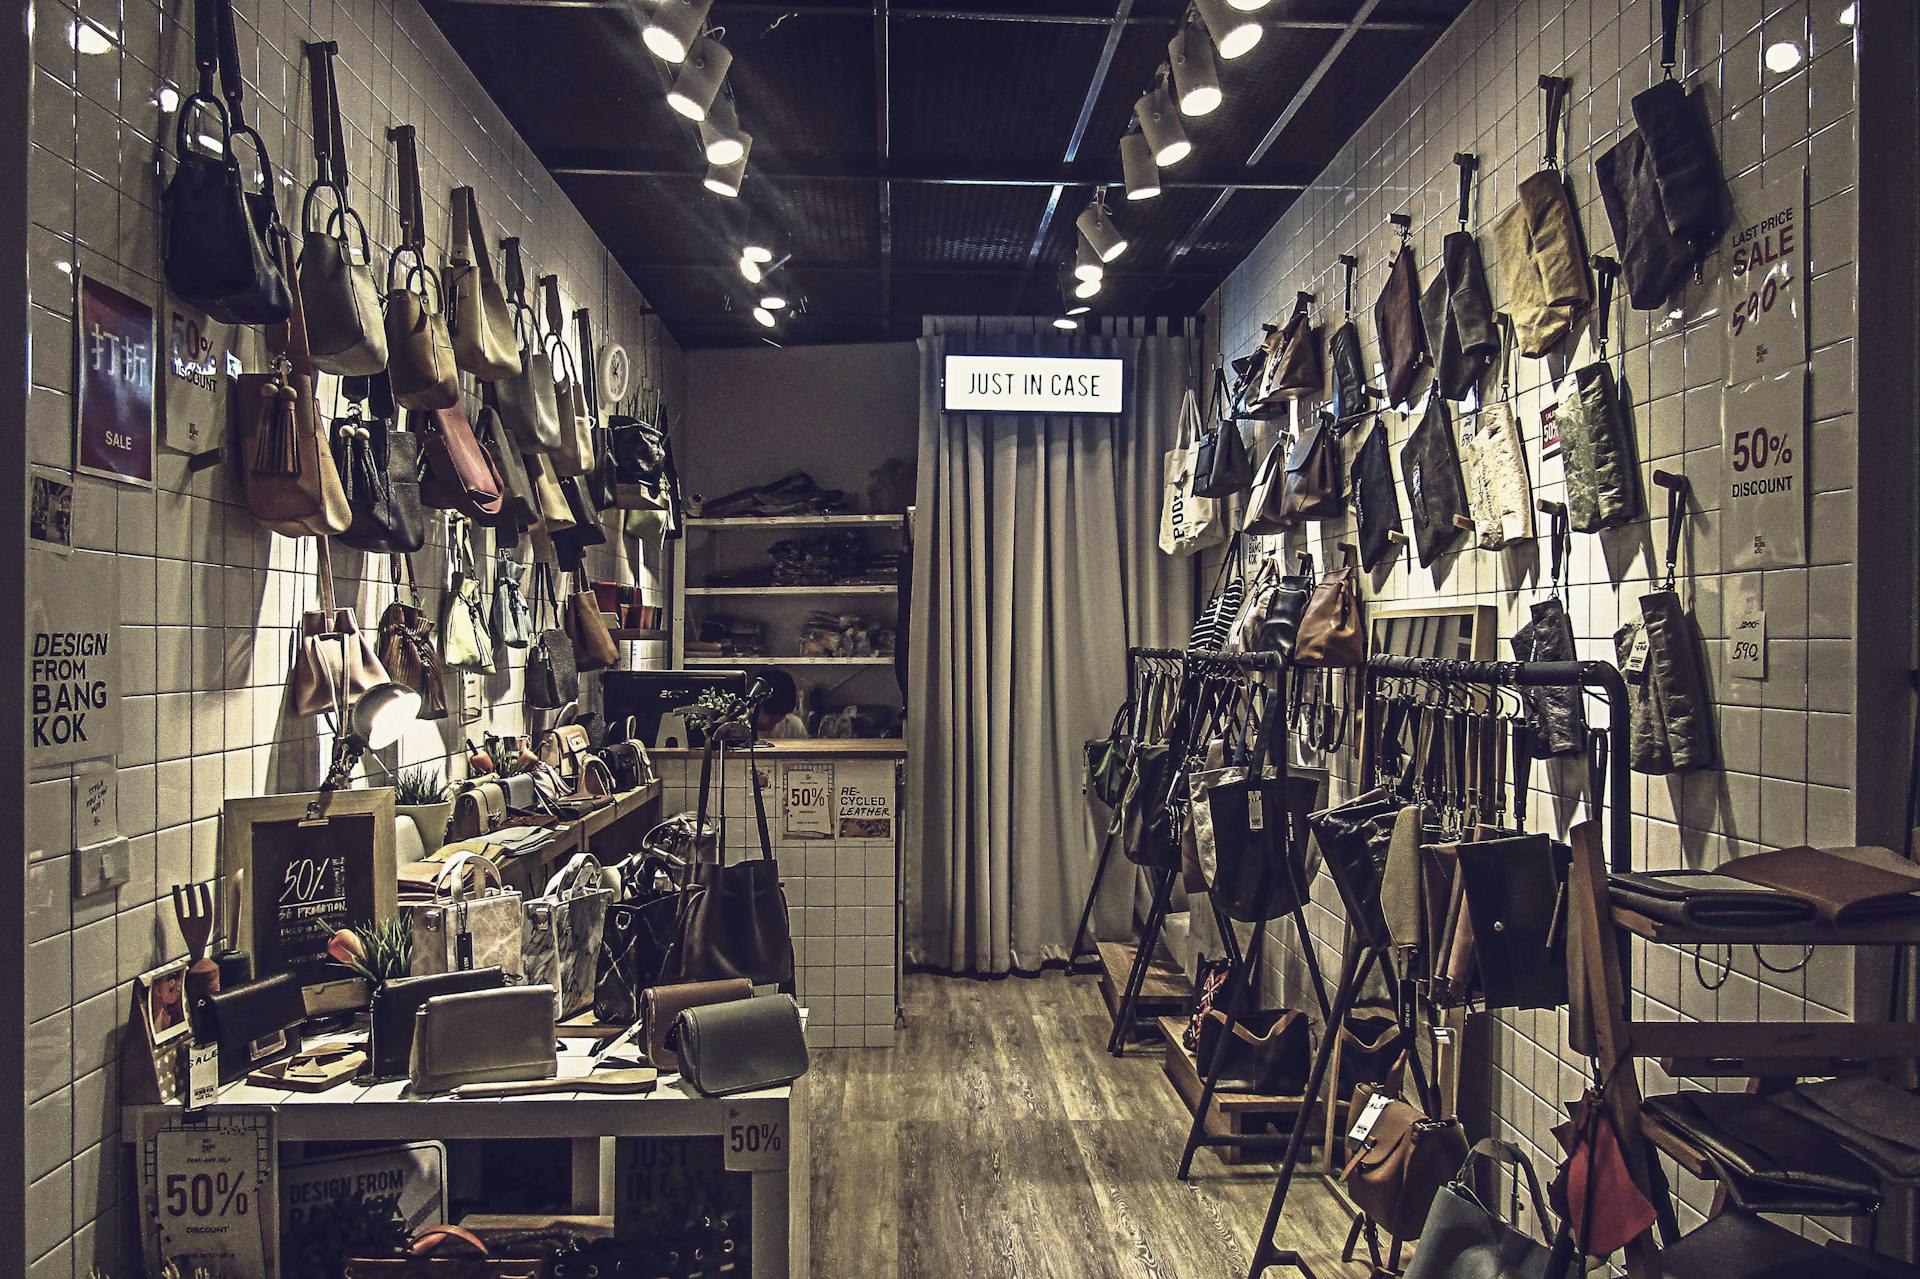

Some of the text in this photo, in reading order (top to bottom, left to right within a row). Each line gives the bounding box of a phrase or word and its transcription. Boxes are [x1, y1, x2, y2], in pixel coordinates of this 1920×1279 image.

[1732, 207, 1794, 249] LAST PRICE
[1732, 223, 1794, 277] SALE
[171, 311, 218, 369] 50%
[91, 322, 147, 388] 打折
[968, 372, 1101, 397] JUST IN CASE
[105, 430, 133, 451] SALE
[1731, 427, 1793, 472] 50%
[1731, 475, 1793, 498] DISCOUNT
[33, 632, 109, 658] DESIGN
[33, 659, 86, 682] FROM
[33, 681, 107, 715] BANG
[33, 712, 88, 748] KOK
[791, 787, 825, 807] 50%
[840, 787, 860, 796] RE-
[840, 796, 886, 806] CYCLED
[839, 806, 891, 817] LEATHER
[279, 857, 330, 902] 50%
[189, 1049, 218, 1069] SALE
[731, 1123, 781, 1153] 50%
[166, 1171, 249, 1217] 50%
[289, 1168, 404, 1205] DESIGN FROM
[186, 1226, 230, 1235] DISCOUNT
